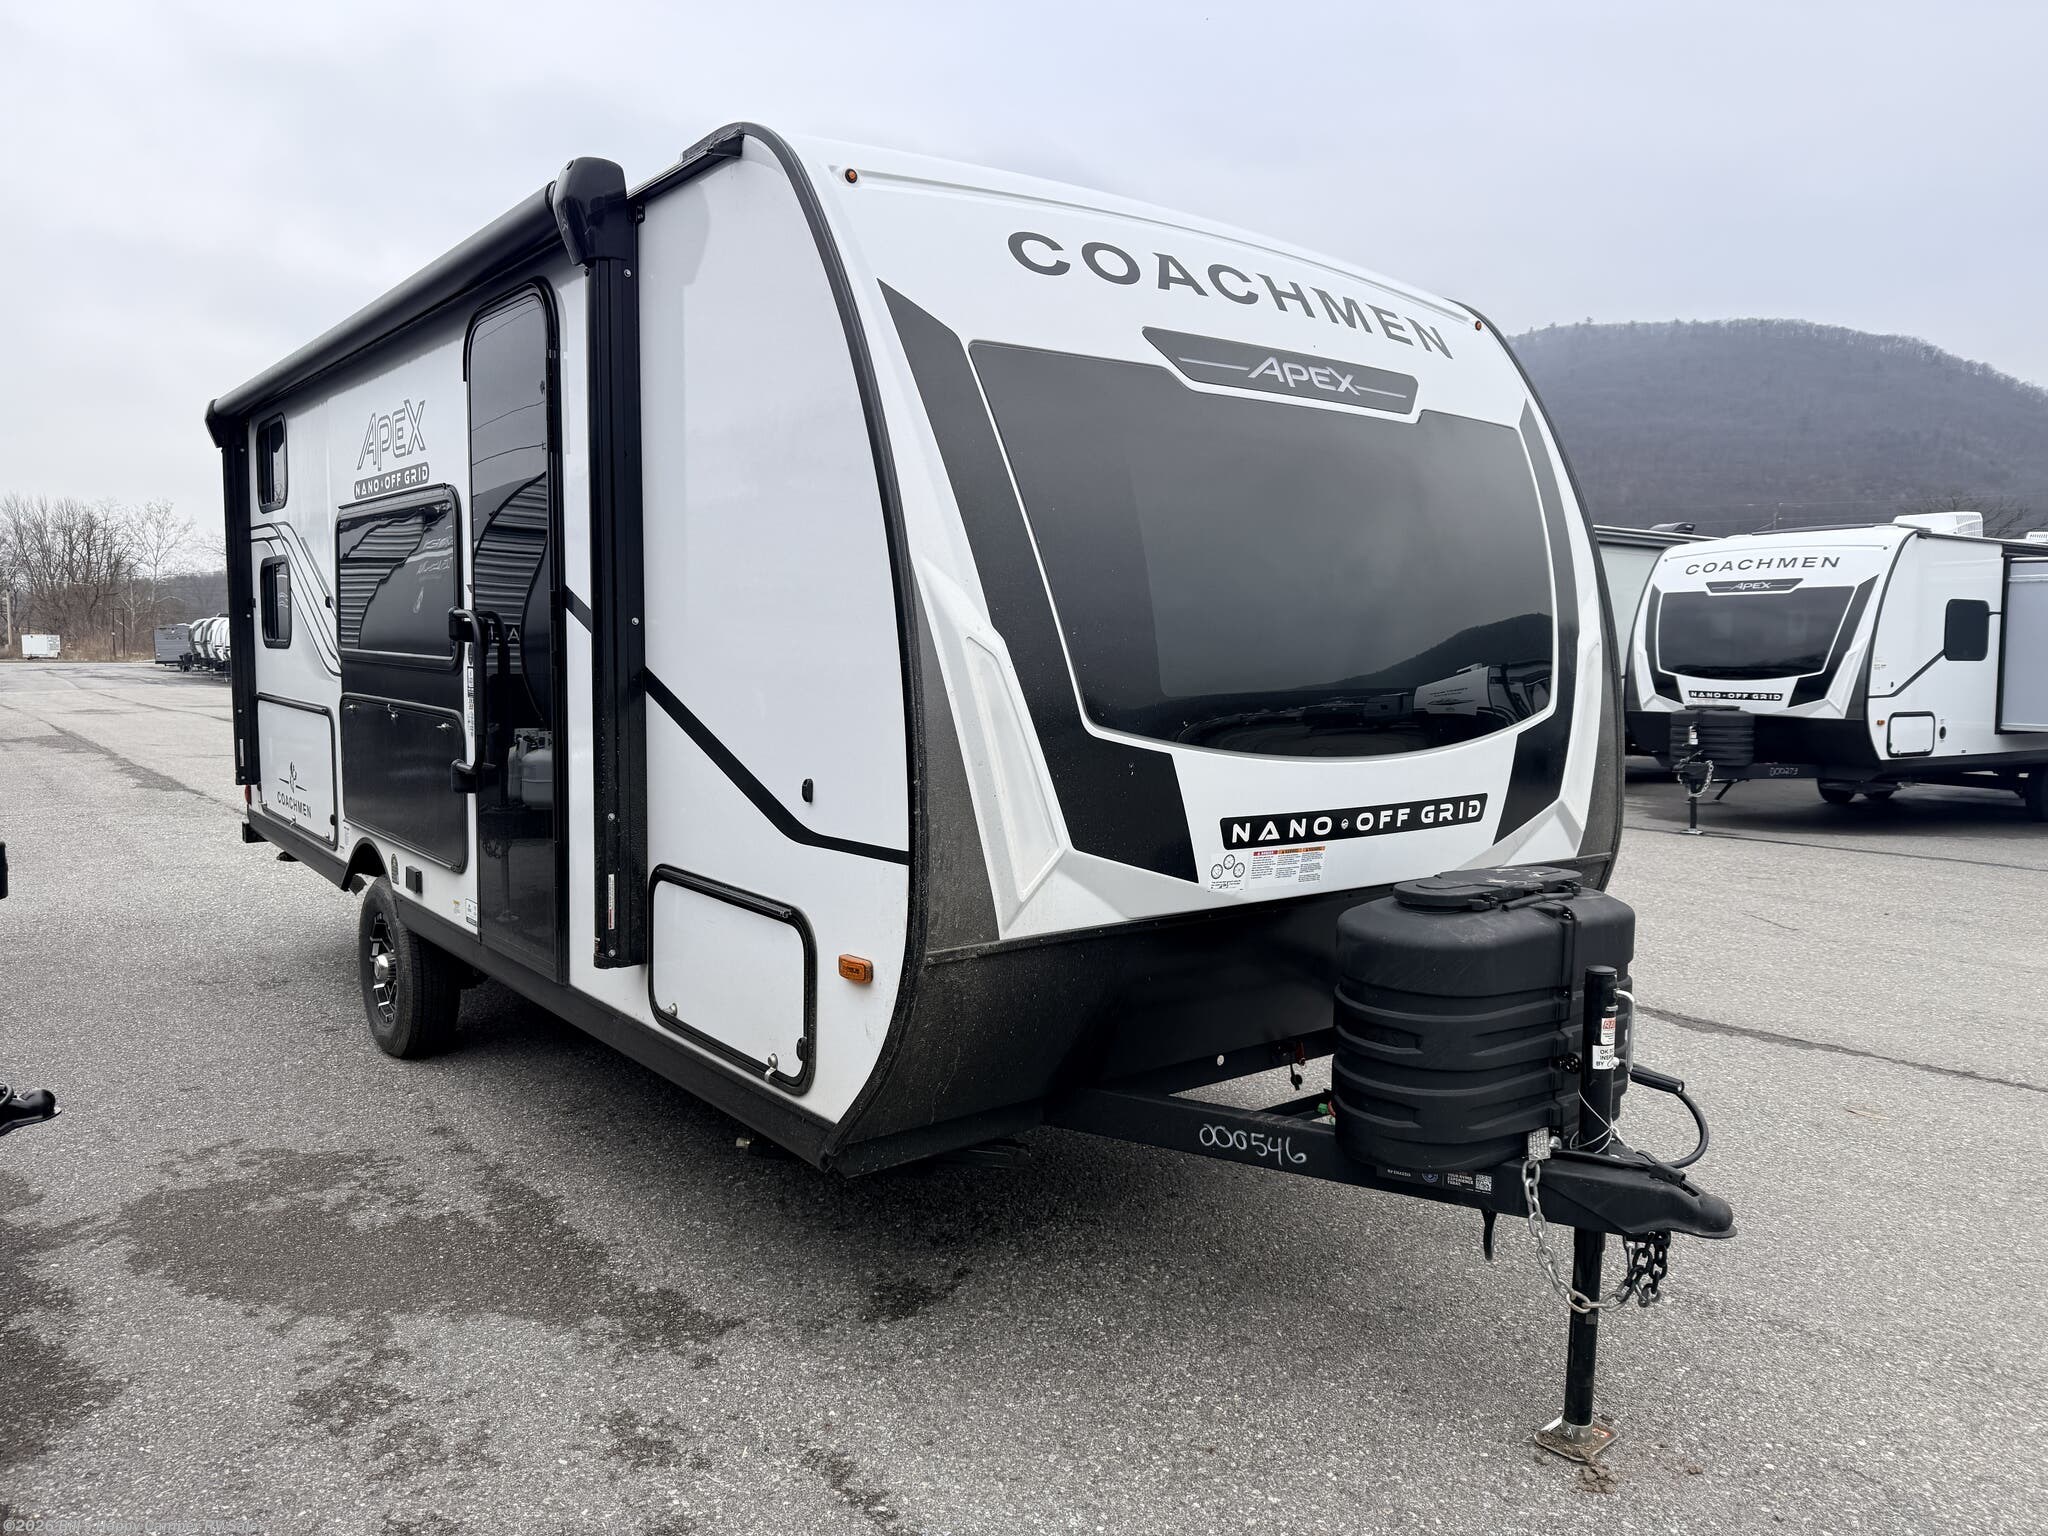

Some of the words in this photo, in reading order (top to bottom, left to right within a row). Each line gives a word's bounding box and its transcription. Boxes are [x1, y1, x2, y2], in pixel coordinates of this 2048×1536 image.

[1007, 231, 1454, 360] COACHMEN
[1247, 356, 1361, 396] APEX
[356, 399, 426, 472] APEX
[355, 479, 379, 497] NANO
[384, 472, 401, 490] OFF
[404, 465, 428, 484] GRID
[1685, 556, 1840, 575] COACHMEN
[1729, 581, 1772, 591] APEX
[276, 791, 312, 819] COACHMEN
[1231, 816, 1333, 844] NANO
[1355, 808, 1410, 831] OFF
[1420, 800, 1481, 824] GRID
[1199, 1123, 1308, 1166] 000546
